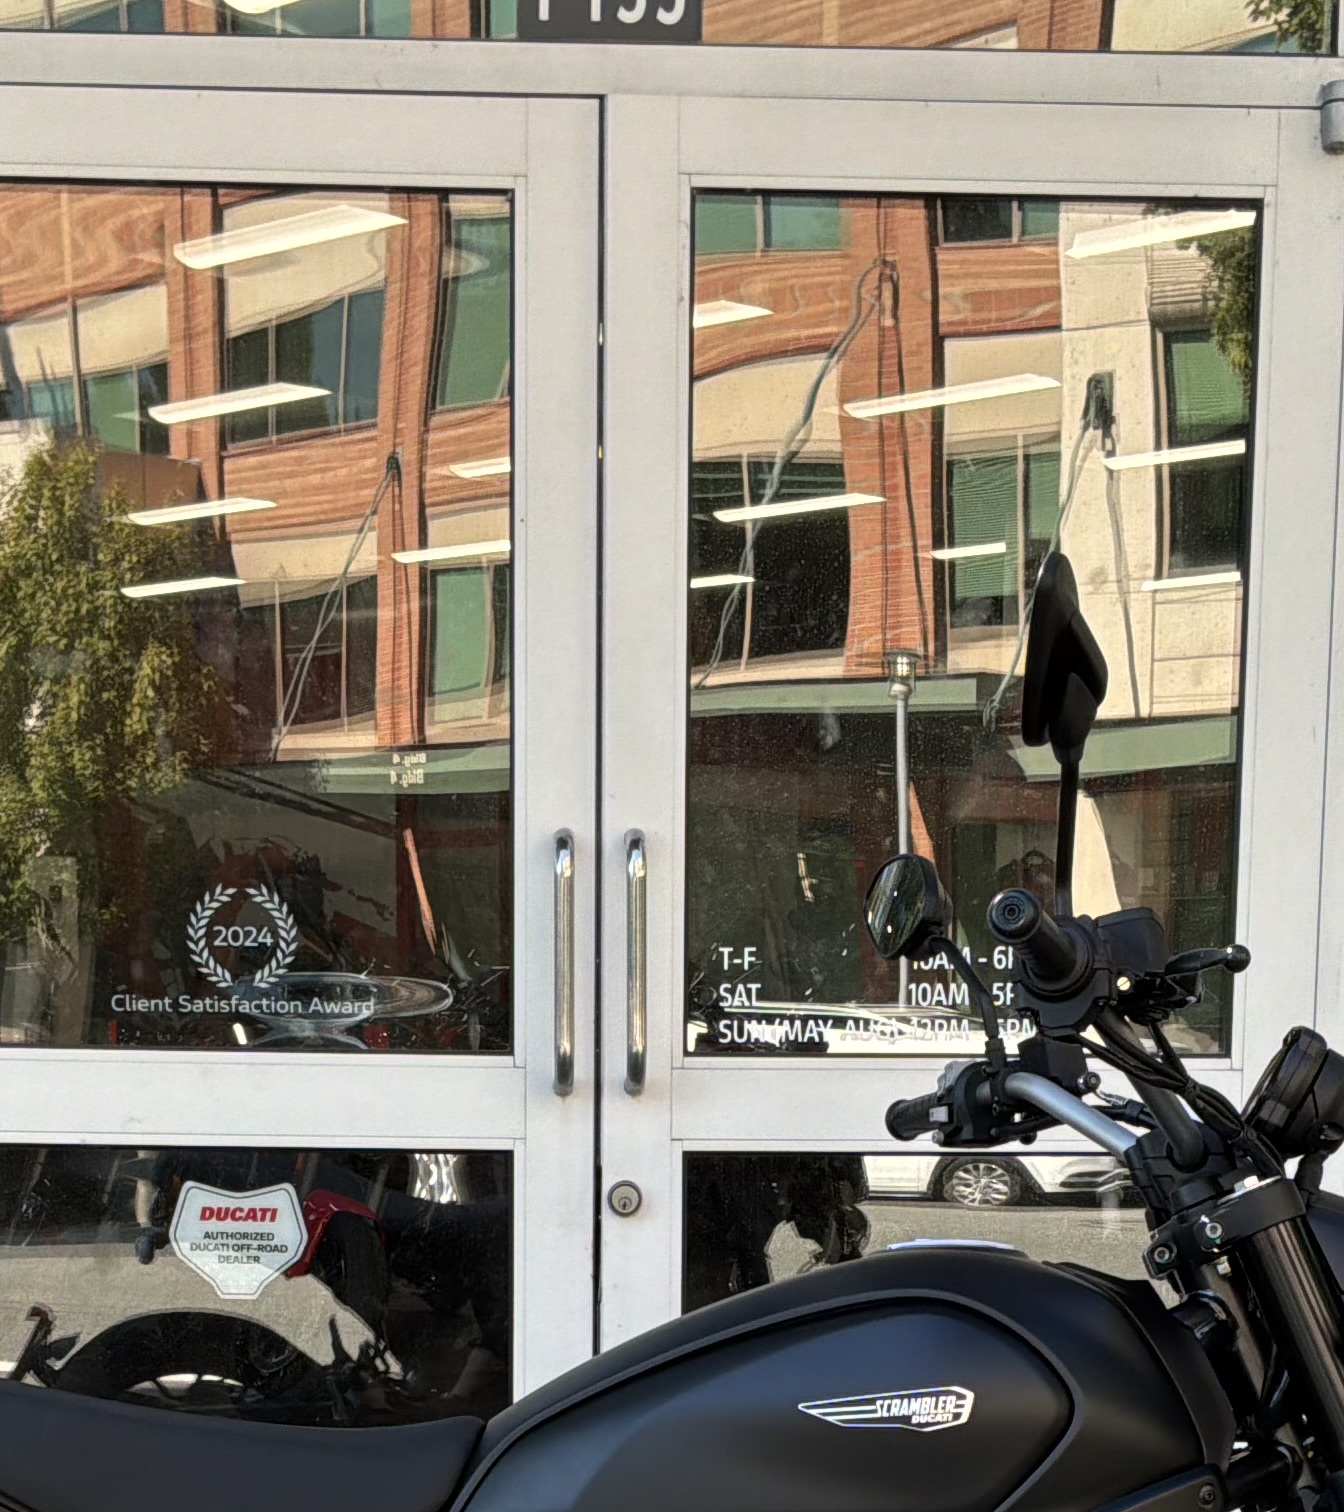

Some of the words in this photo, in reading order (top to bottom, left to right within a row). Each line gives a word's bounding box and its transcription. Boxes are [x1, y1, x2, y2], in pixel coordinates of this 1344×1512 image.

[213, 926, 274, 947] 2024
[718, 946, 757, 971] T-F
[718, 983, 762, 1007] SAT
[908, 982, 970, 1007] 10AM
[111, 994, 174, 1013] Client
[178, 994, 302, 1015] Satisfaction
[308, 996, 375, 1015] Award
[199, 1206, 279, 1223] DUCATI
[203, 1231, 275, 1242] AUTHORIZED
[189, 1241, 230, 1253] DUCATI
[231, 1243, 289, 1254] OFF-ROAD
[217, 1254, 262, 1265] DEALER
[876, 1395, 957, 1418] SCRAMBLER
[911, 1413, 954, 1425] DUCATI
